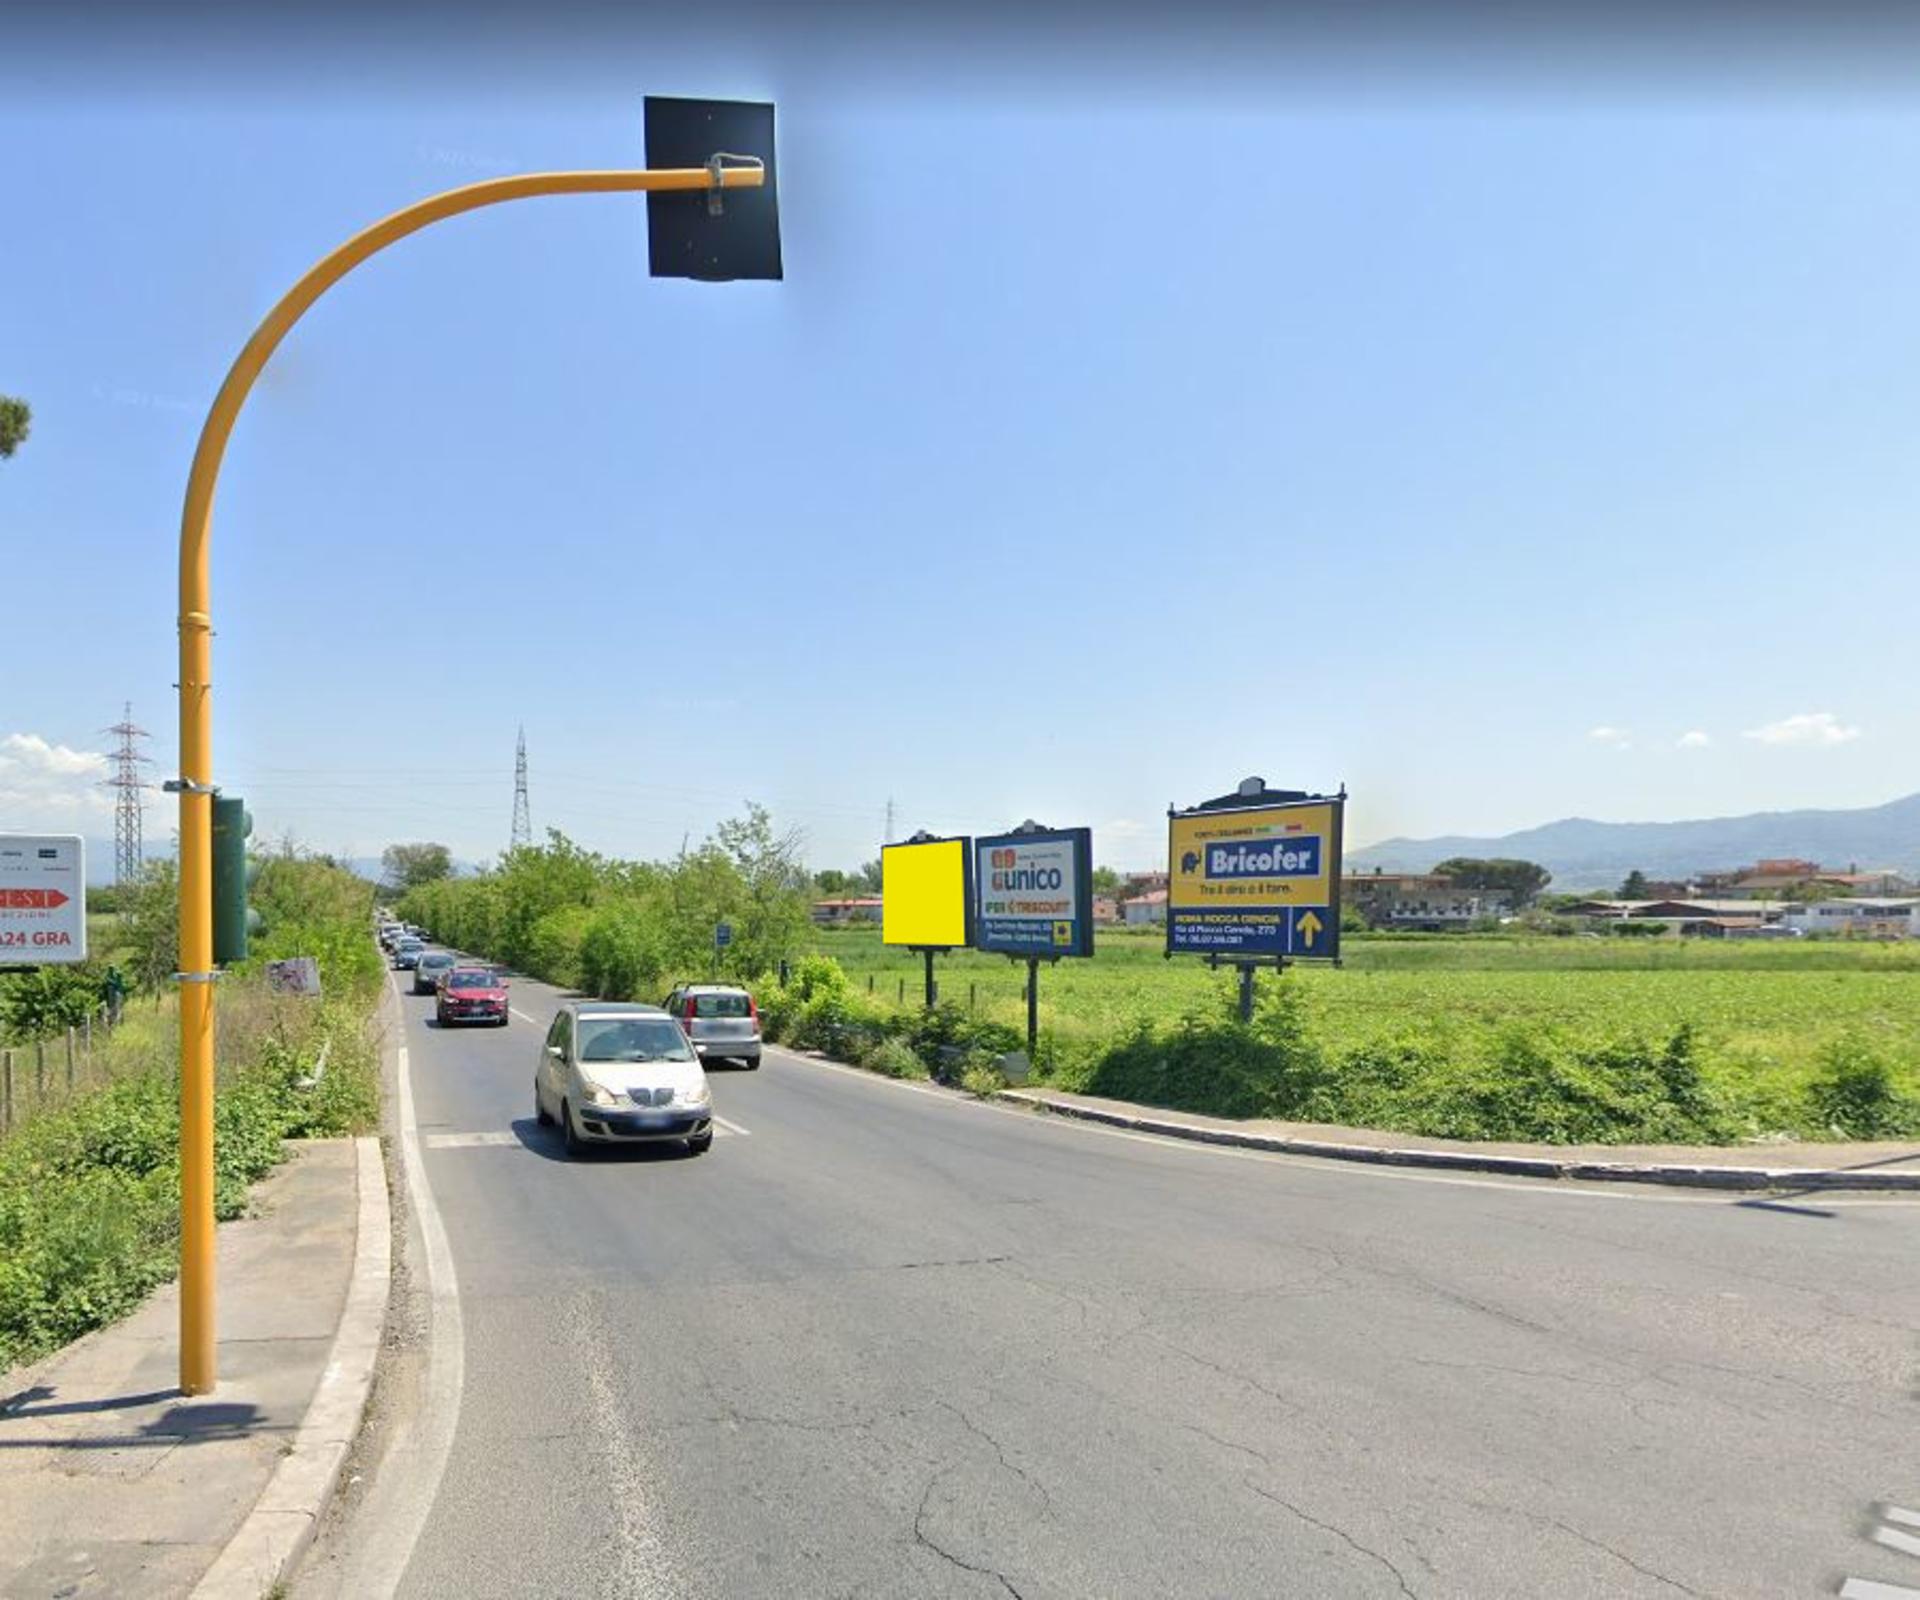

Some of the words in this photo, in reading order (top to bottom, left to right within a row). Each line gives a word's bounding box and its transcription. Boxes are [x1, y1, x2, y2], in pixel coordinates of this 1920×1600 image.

[1211, 843, 1312, 873] Bricofer
[0, 931, 26, 946] 24
[32, 931, 72, 946] GRA
